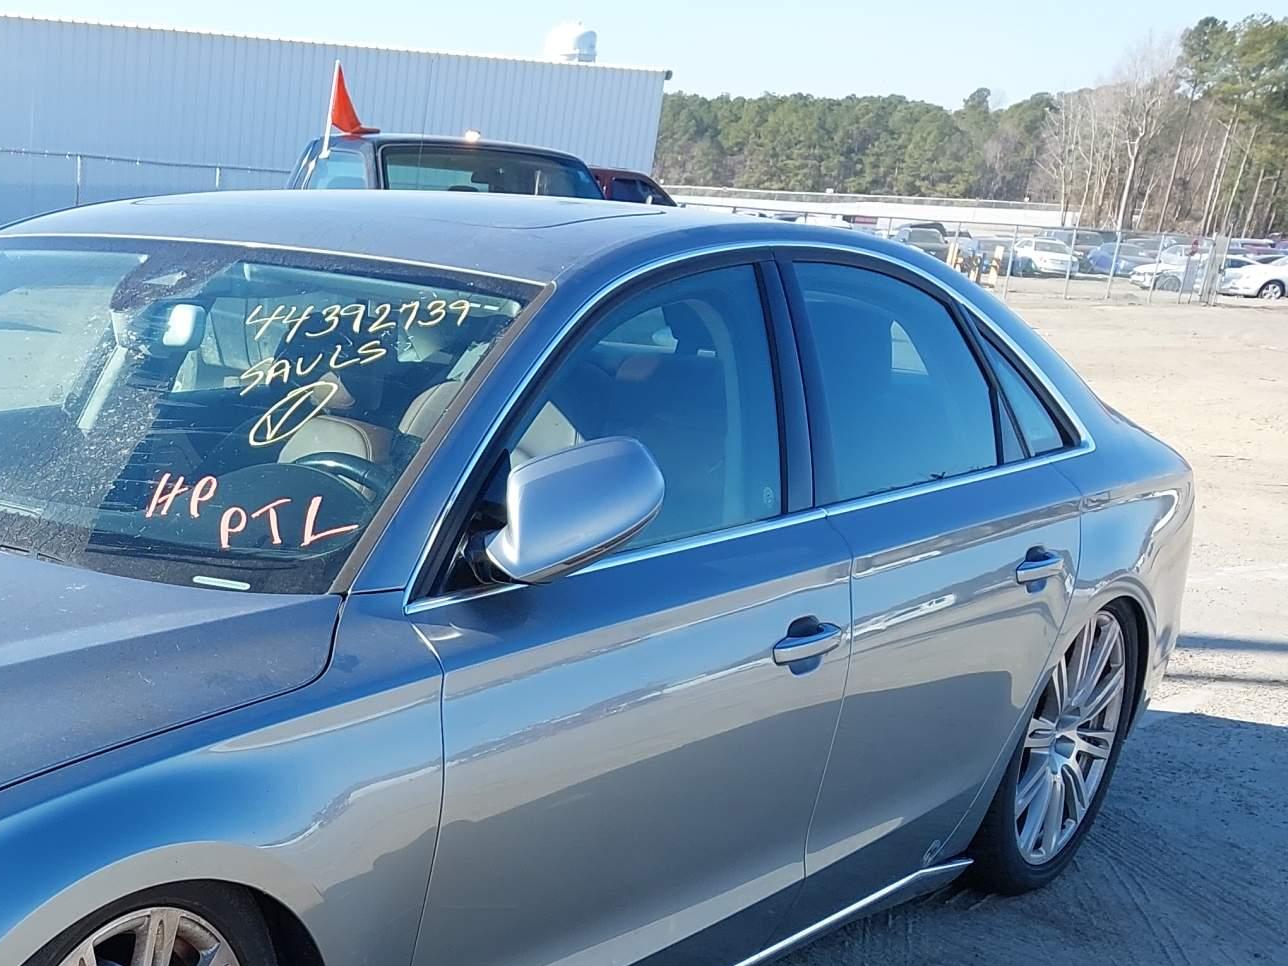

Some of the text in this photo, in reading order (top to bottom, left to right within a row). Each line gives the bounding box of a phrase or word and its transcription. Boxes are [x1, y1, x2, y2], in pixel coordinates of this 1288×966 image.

[245, 300, 471, 342] 44392739
[240, 340, 387, 396] SAULS
[145, 472, 219, 519] HP
[220, 496, 359, 549] PTL
